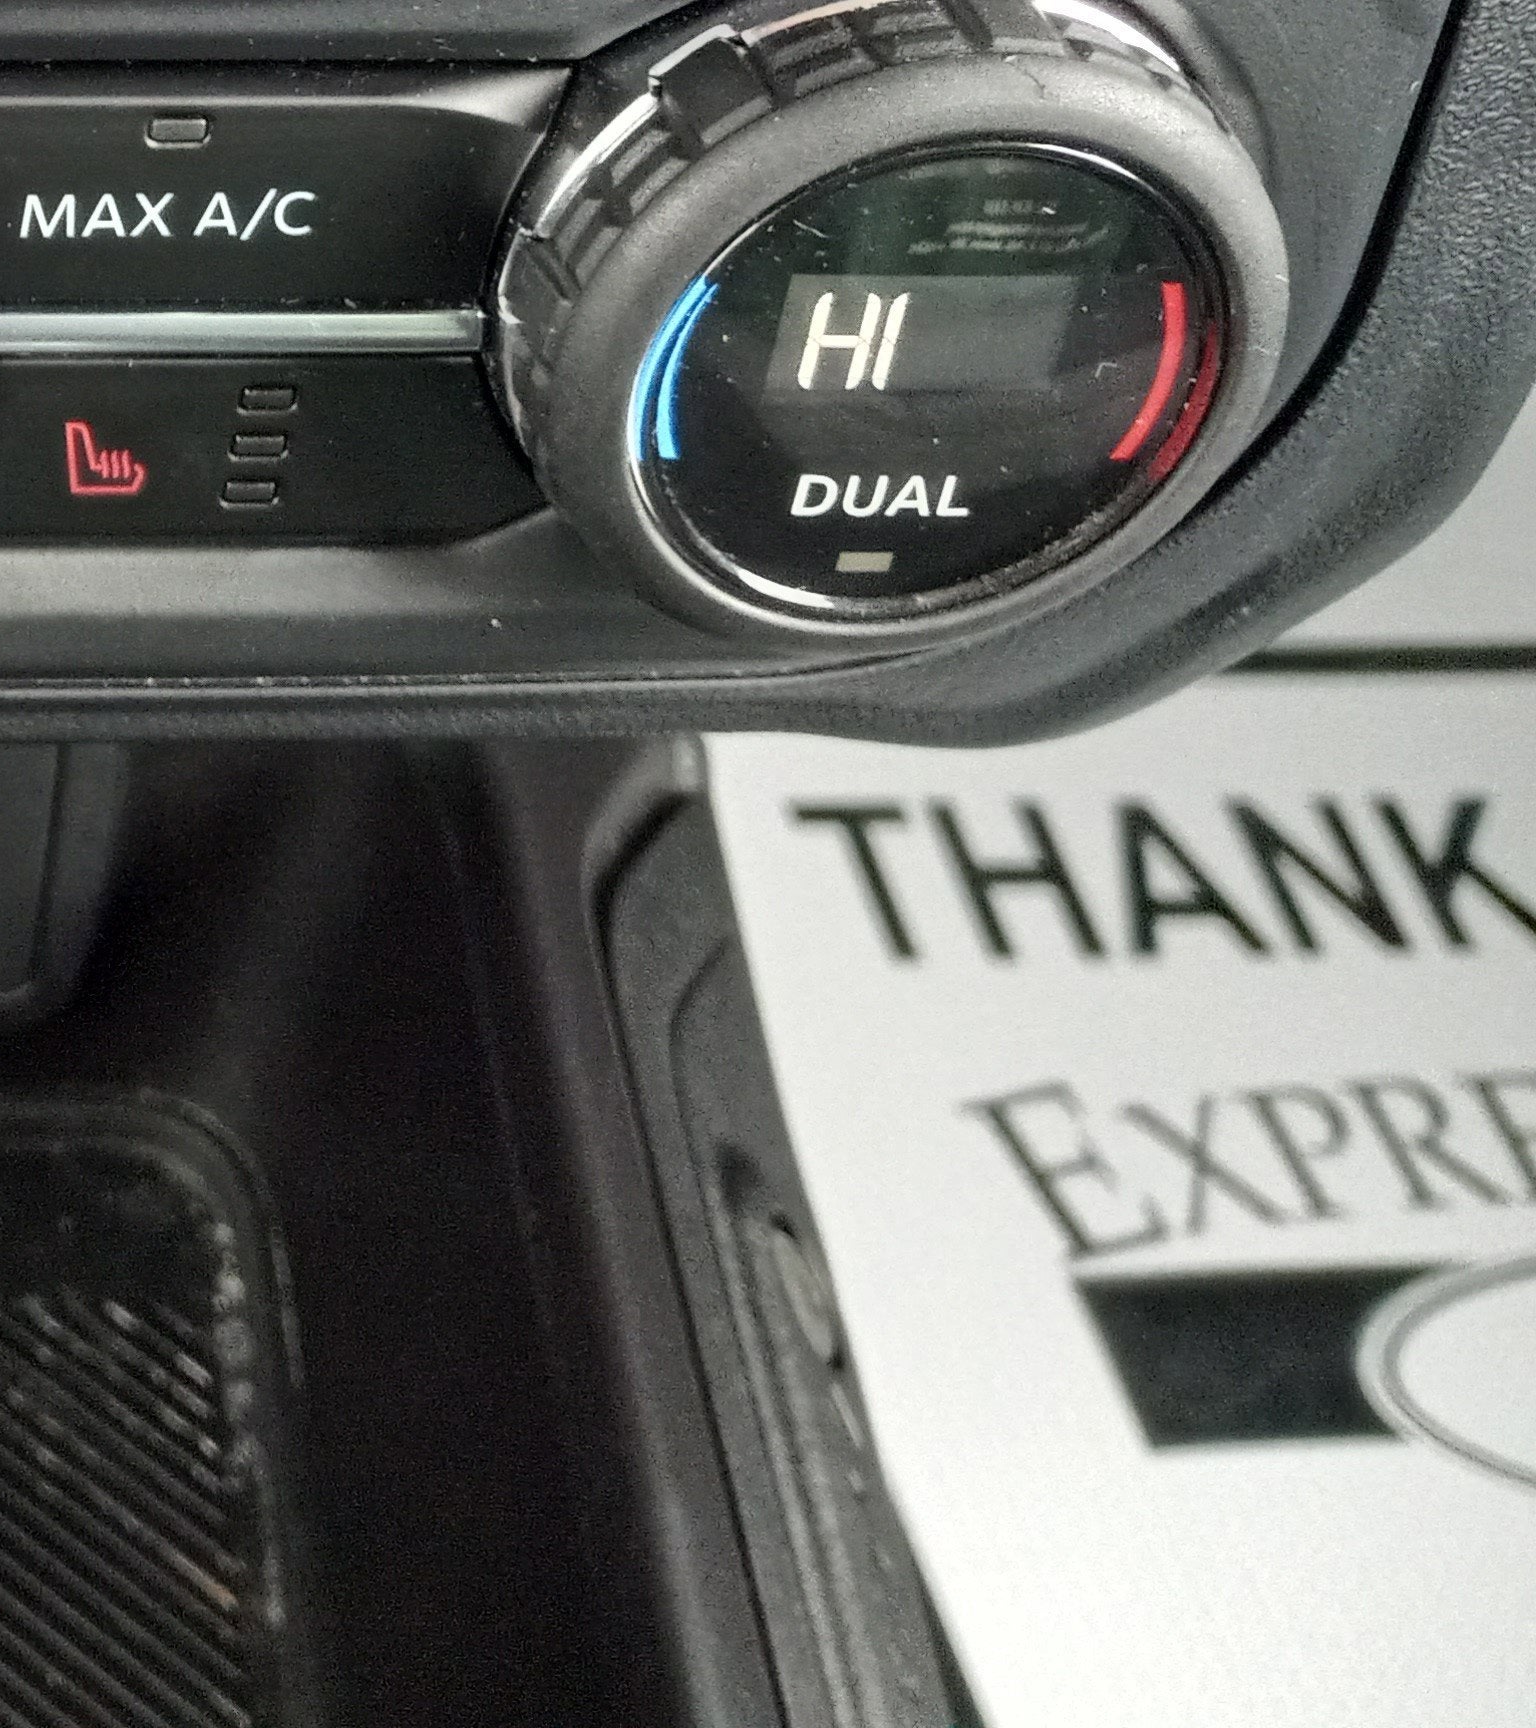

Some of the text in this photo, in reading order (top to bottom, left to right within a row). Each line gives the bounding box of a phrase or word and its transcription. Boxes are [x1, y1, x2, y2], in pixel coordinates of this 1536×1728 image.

[20, 188, 315, 241] MAX A/C
[797, 293, 909, 389] HI
[791, 474, 969, 517] DUAL
[786, 792, 1536, 962] THANK
